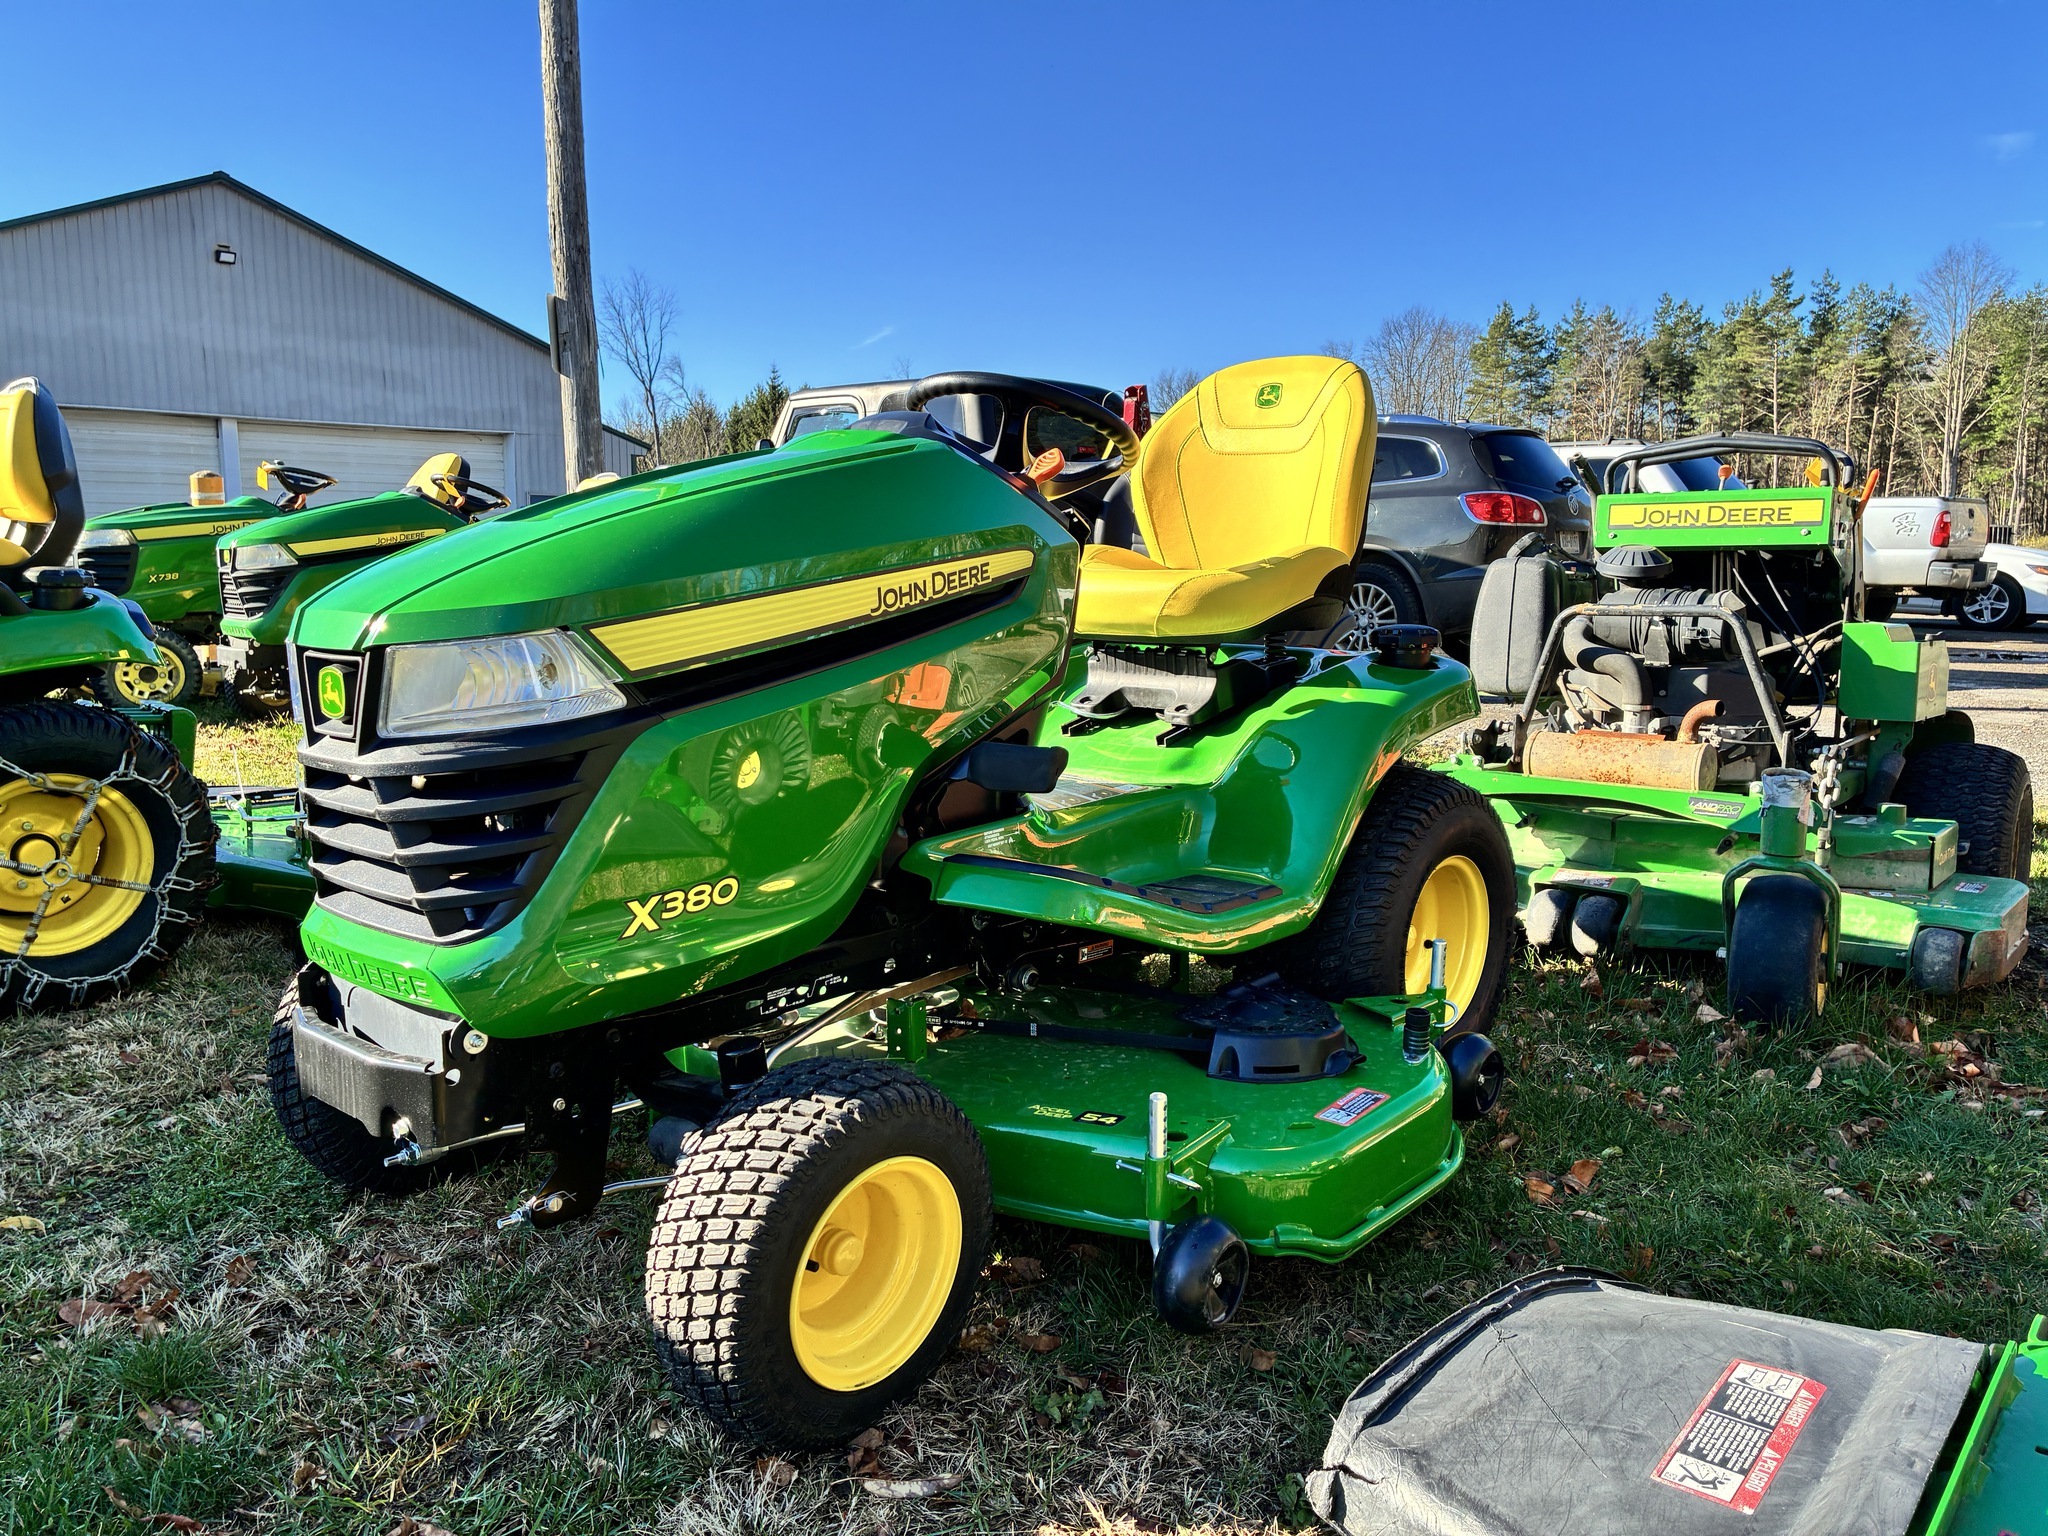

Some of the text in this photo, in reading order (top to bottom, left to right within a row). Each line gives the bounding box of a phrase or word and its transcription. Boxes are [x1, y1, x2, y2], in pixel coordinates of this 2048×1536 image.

[1633, 505, 1793, 525] JOHN DEERE
[209, 524, 240, 535] JOHN
[376, 531, 426, 546] JOHN DEERE
[148, 572, 180, 584] X738
[870, 561, 991, 613] JOHN DEERE
[1689, 800, 1742, 813] LANDPRO
[618, 875, 740, 941] X380
[306, 933, 433, 1004] JOHN DEERE
[1027, 1104, 1118, 1125] ACCEL 54
[1033, 1109, 1073, 1119] DEEP
[1782, 1397, 1814, 1429] DANGER
[1744, 1455, 1779, 1494] PELIGRO
